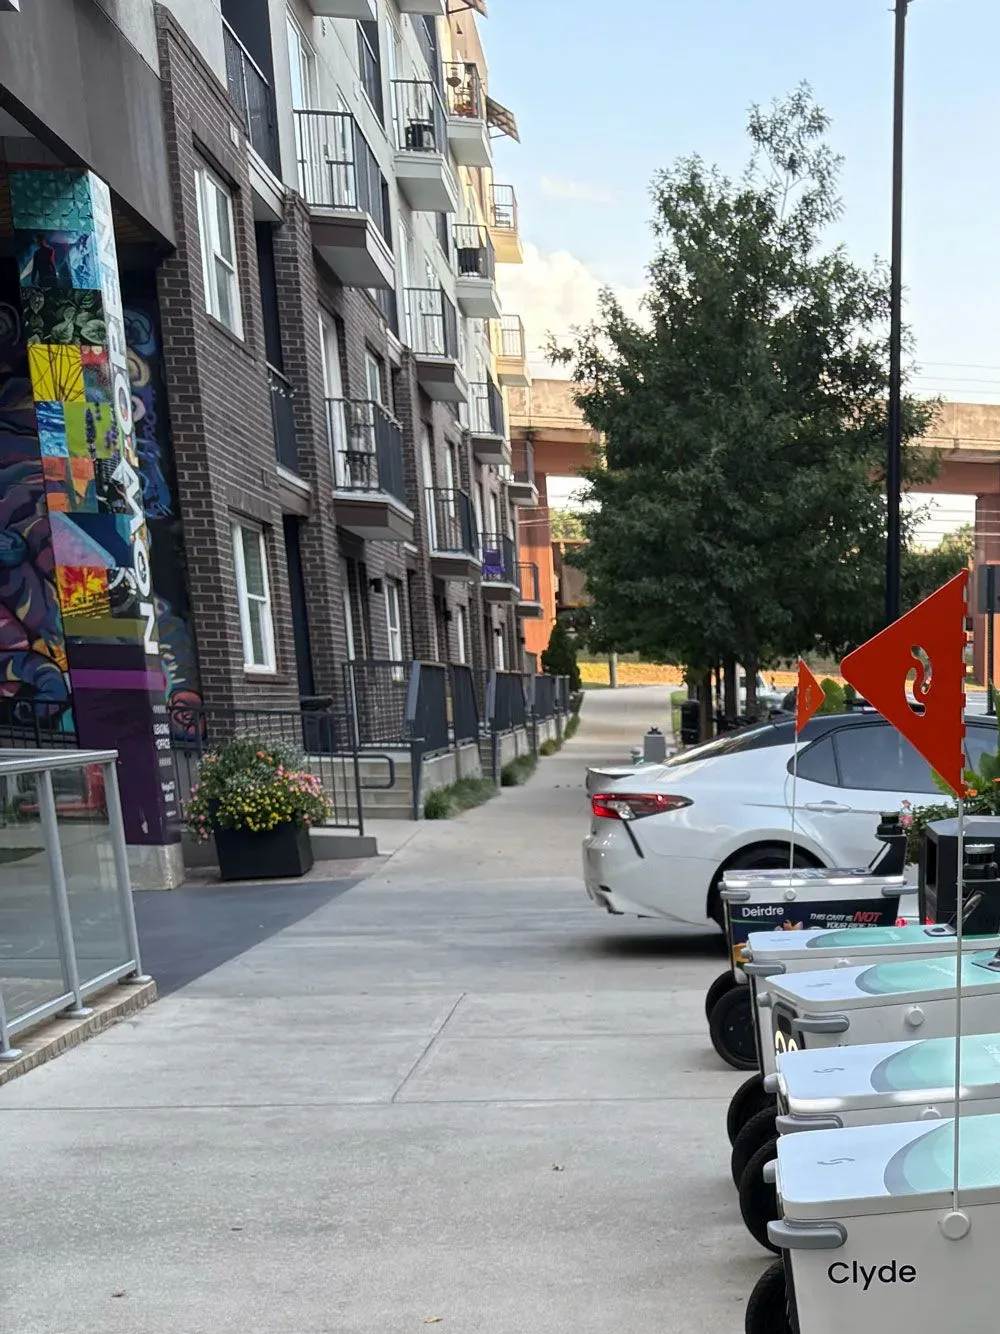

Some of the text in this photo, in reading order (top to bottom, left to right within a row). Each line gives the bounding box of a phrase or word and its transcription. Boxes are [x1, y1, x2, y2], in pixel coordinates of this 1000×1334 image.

[95, 206, 160, 655] NOW OPEN
[742, 906, 785, 917] Deirdre
[854, 911, 882, 923] NOT
[828, 1260, 916, 1290] Clyde
